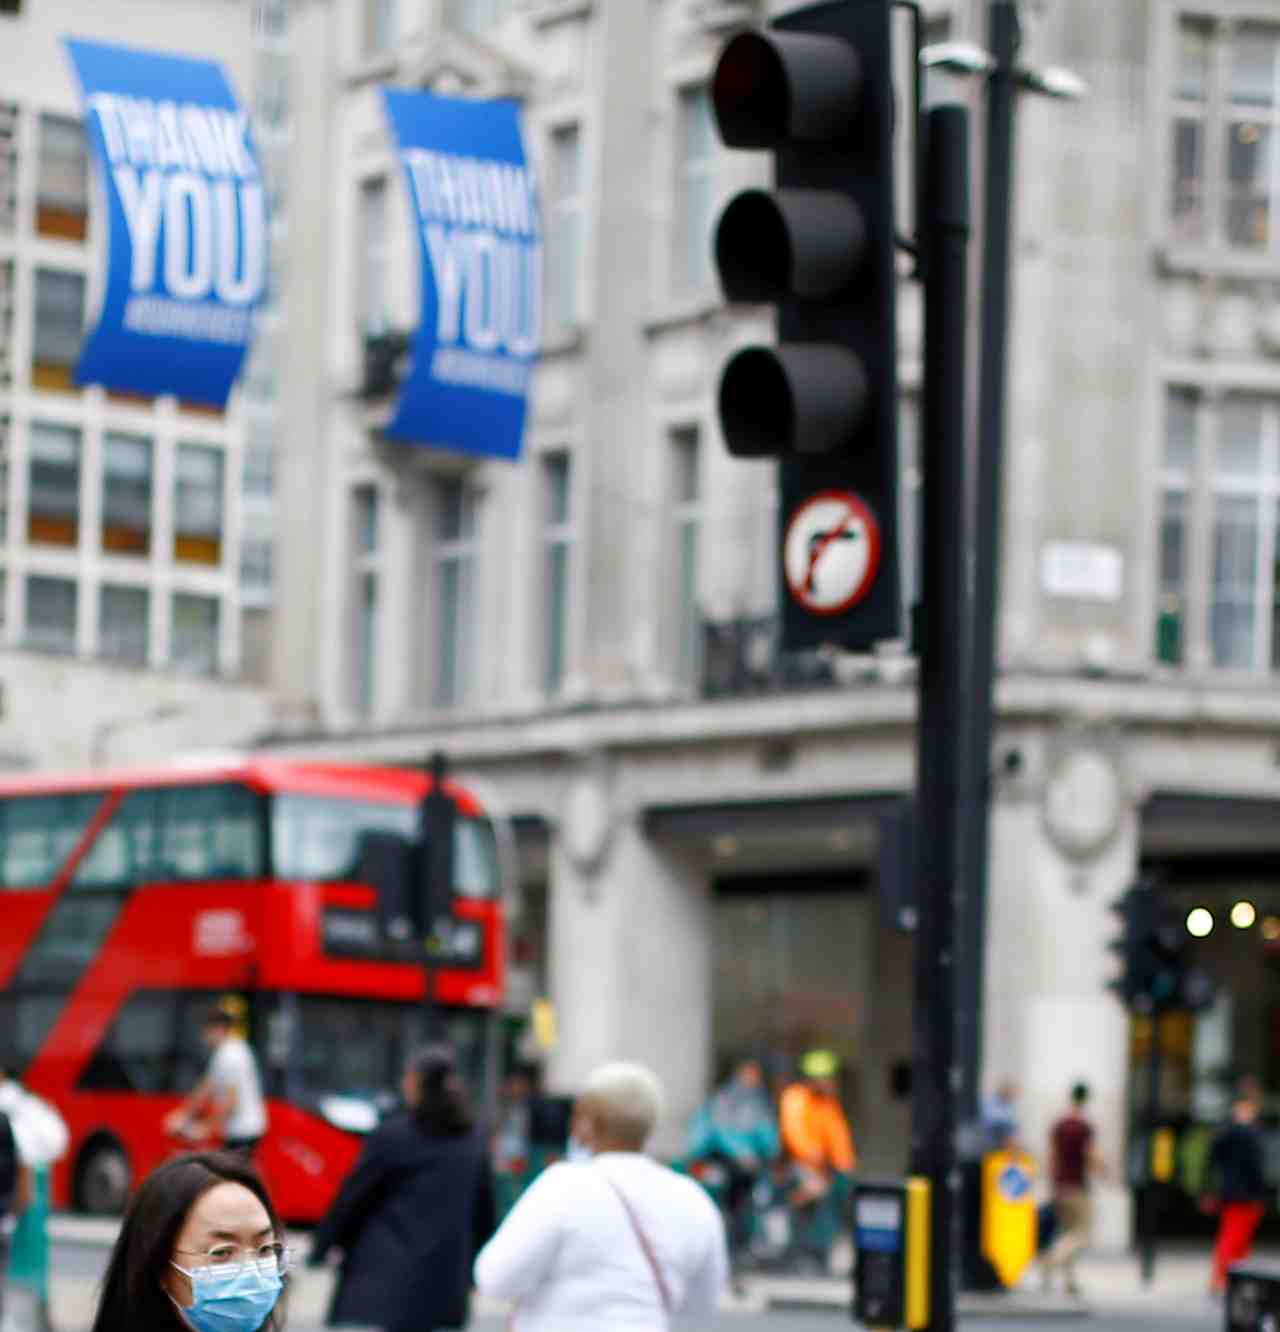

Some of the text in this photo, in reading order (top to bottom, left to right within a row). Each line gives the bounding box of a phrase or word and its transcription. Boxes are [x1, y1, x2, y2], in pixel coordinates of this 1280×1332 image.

[88, 90, 261, 181] THANK
[111, 164, 266, 305] YOU
[424, 221, 545, 358] YOU
